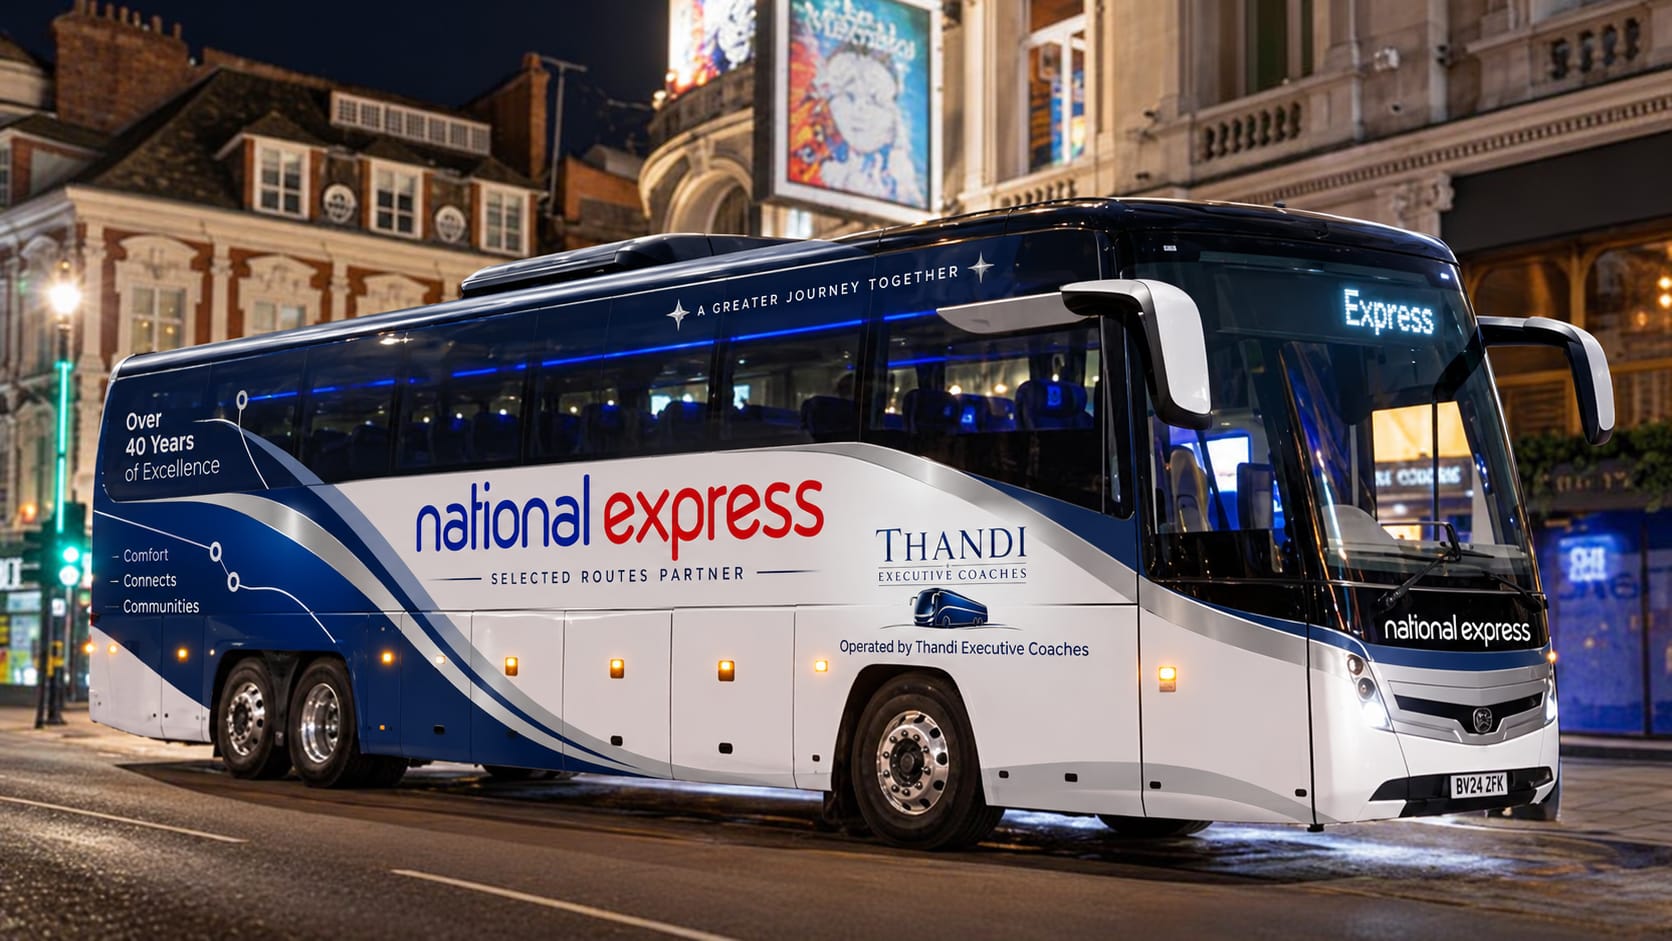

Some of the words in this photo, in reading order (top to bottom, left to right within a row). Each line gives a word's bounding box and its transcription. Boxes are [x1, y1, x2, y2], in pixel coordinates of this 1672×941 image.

[697, 305, 705, 317] A
[712, 294, 778, 314] GREATER
[786, 281, 859, 303] JOURNEY
[868, 265, 959, 290] TOGETHER
[1344, 288, 1434, 336] Express
[126, 412, 162, 431] Over
[125, 437, 146, 456] 40
[150, 434, 195, 454] Years
[124, 464, 141, 482] of
[143, 459, 220, 480] Excellence
[416, 474, 590, 553] national
[603, 479, 825, 561] express
[875, 526, 1027, 562] THANDI
[123, 549, 169, 562] Comfort
[123, 574, 177, 588] Connects
[491, 571, 571, 585] SELECTED
[581, 569, 648, 583] ROUTES
[659, 566, 744, 581] PARTNER
[878, 570, 952, 582] EXECUTIVE
[958, 568, 1027, 580] COACHES
[123, 599, 200, 614] Communities
[1384, 613, 1458, 640] national
[1461, 621, 1531, 647] express
[839, 640, 894, 654] Operated
[897, 640, 912, 656] by
[915, 640, 958, 654] Thandi
[961, 641, 1025, 655] Executive
[1028, 641, 1089, 656] Coaches
[1456, 777, 1483, 795] BV24
[1485, 775, 1504, 792] ZFK
